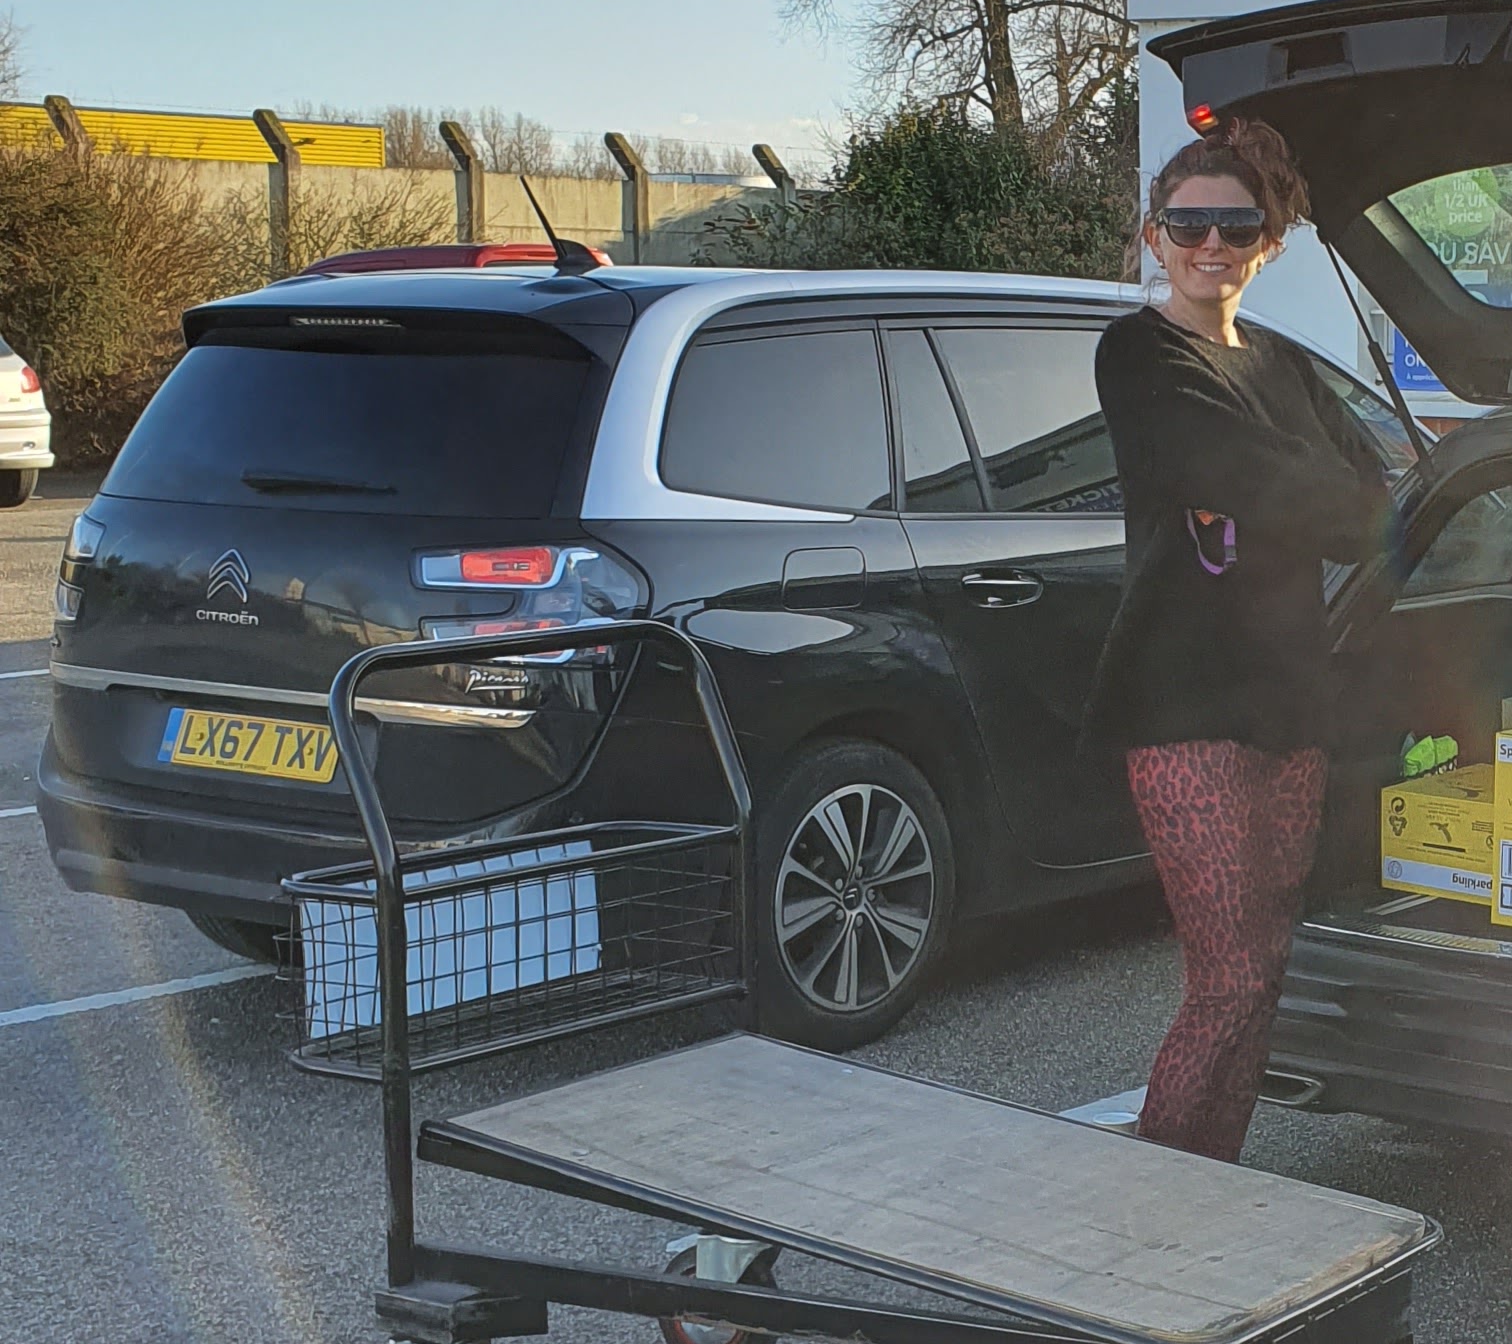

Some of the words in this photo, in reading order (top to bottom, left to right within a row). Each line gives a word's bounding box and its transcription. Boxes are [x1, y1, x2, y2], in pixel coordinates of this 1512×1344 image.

[1453, 179, 1478, 192] than
[1444, 193, 1465, 208] 1/2
[1449, 209, 1483, 225] price
[179, 714, 266, 761] LX67
[271, 725, 334, 772] TXV
[1452, 873, 1493, 891] parkling
